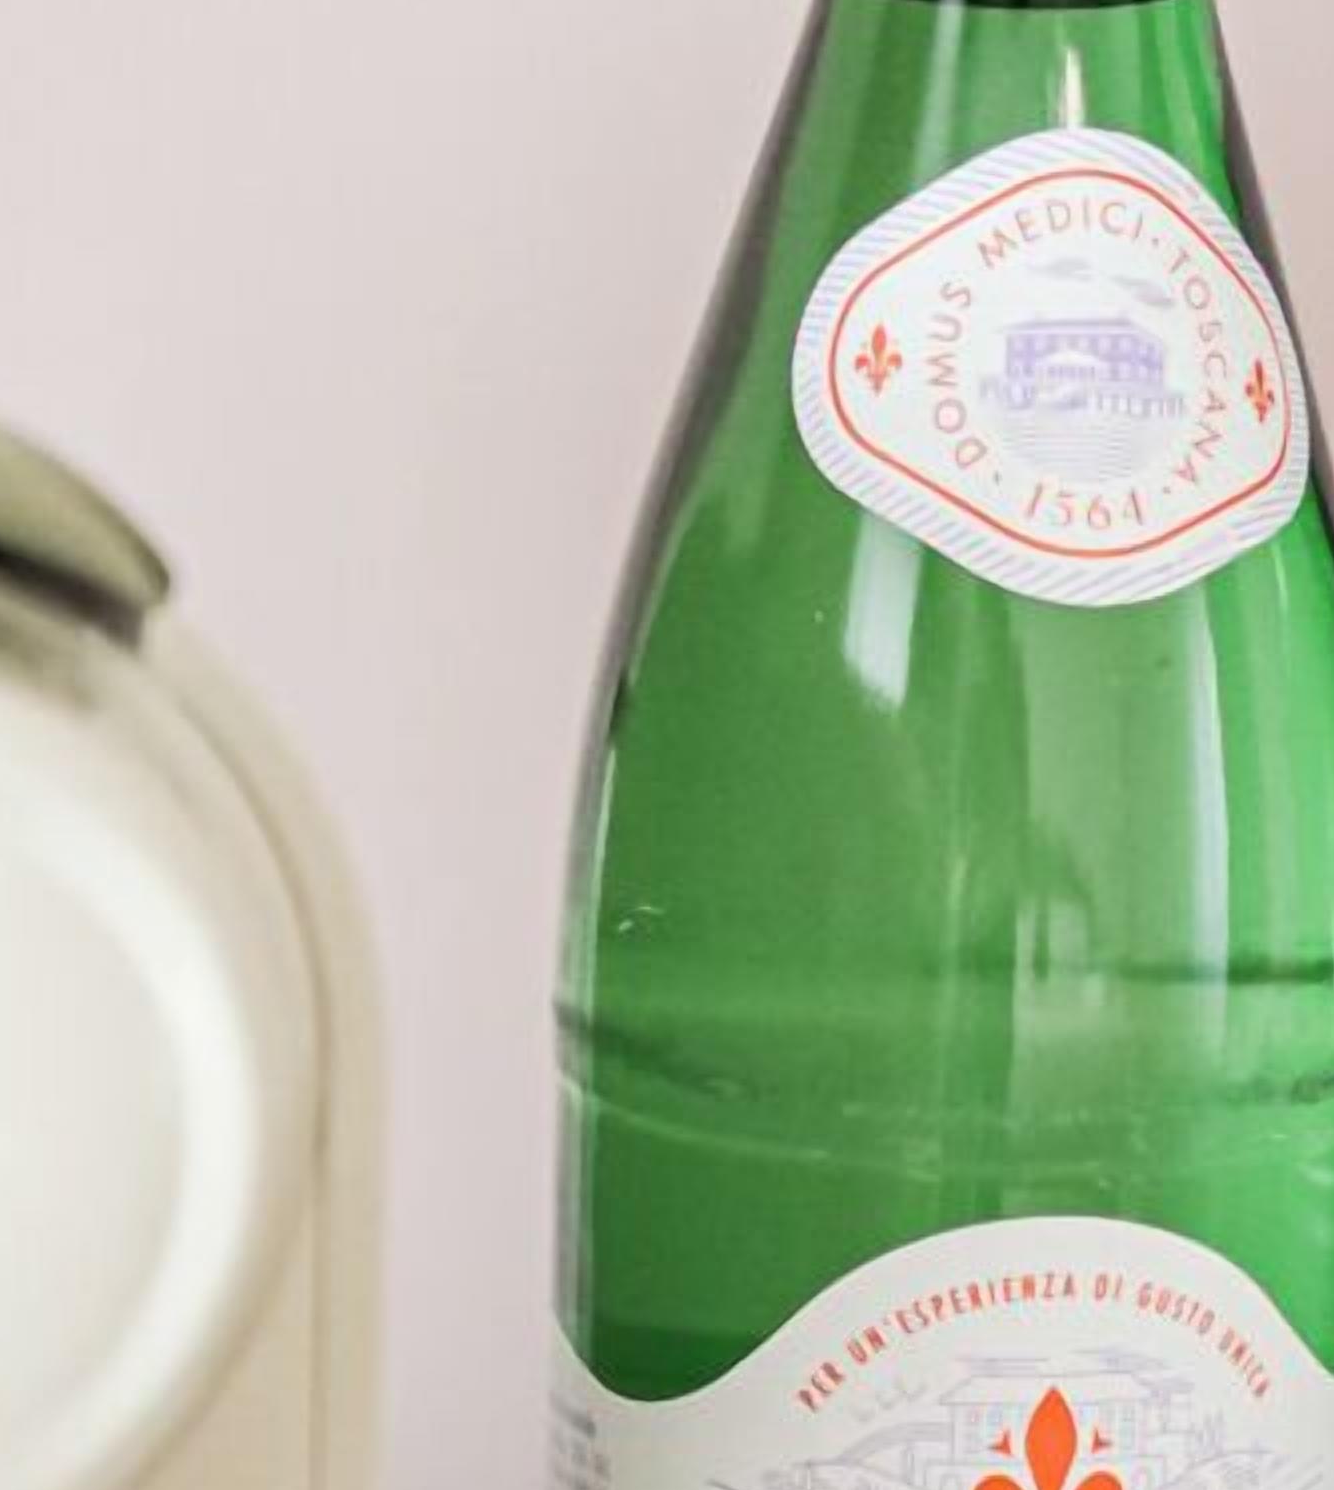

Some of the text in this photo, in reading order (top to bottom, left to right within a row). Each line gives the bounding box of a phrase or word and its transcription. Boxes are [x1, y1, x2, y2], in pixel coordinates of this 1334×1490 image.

[925, 195, 1229, 488] DOMUS MEDICI TOSCANA
[1025, 478, 1147, 533] 1564
[1093, 1272, 1124, 1301] DI
[1137, 1280, 1217, 1337] GUSTO
